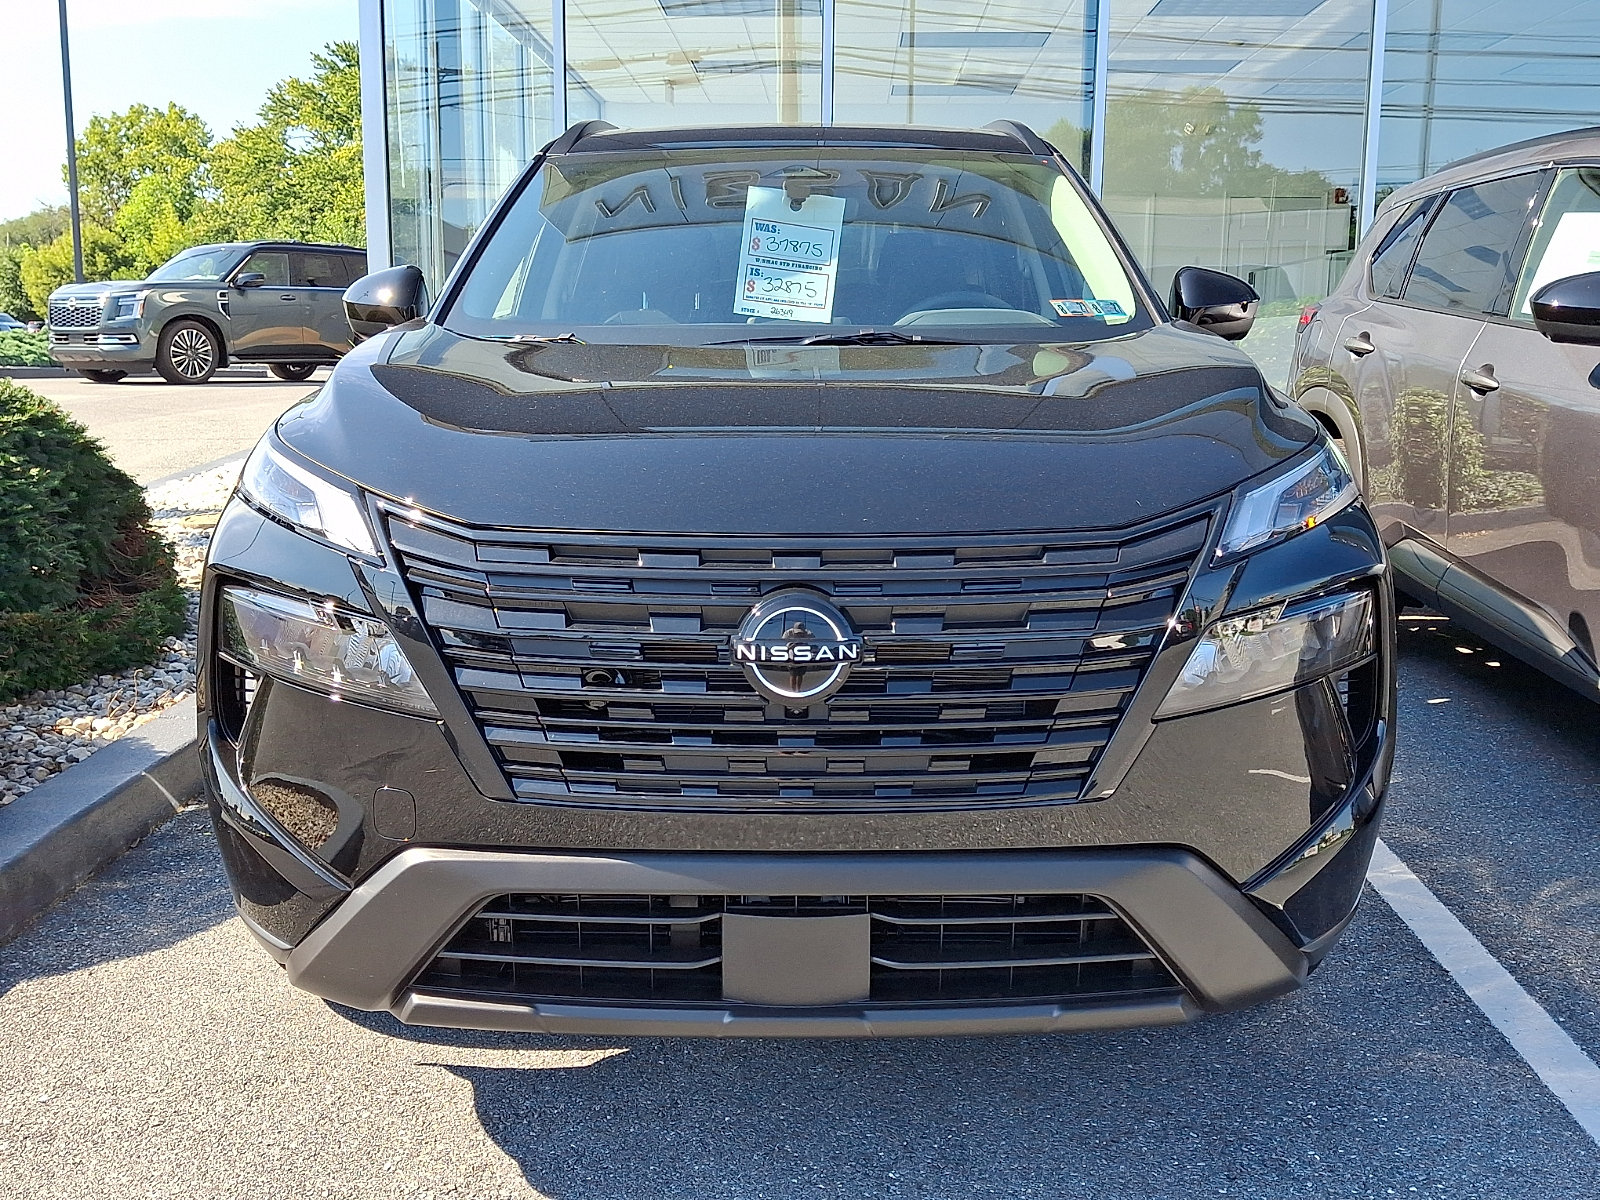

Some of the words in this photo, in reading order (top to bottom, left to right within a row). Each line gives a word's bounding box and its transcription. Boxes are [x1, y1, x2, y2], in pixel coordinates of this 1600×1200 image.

[754, 222, 781, 235] WAS:
[751, 236, 761, 251] $
[765, 236, 823, 258] 37875
[749, 267, 764, 278] IS:
[791, 261, 823, 272] FINANCING
[746, 279, 756, 293] $
[762, 276, 817, 299] 32875
[737, 644, 857, 661] NISSAN
